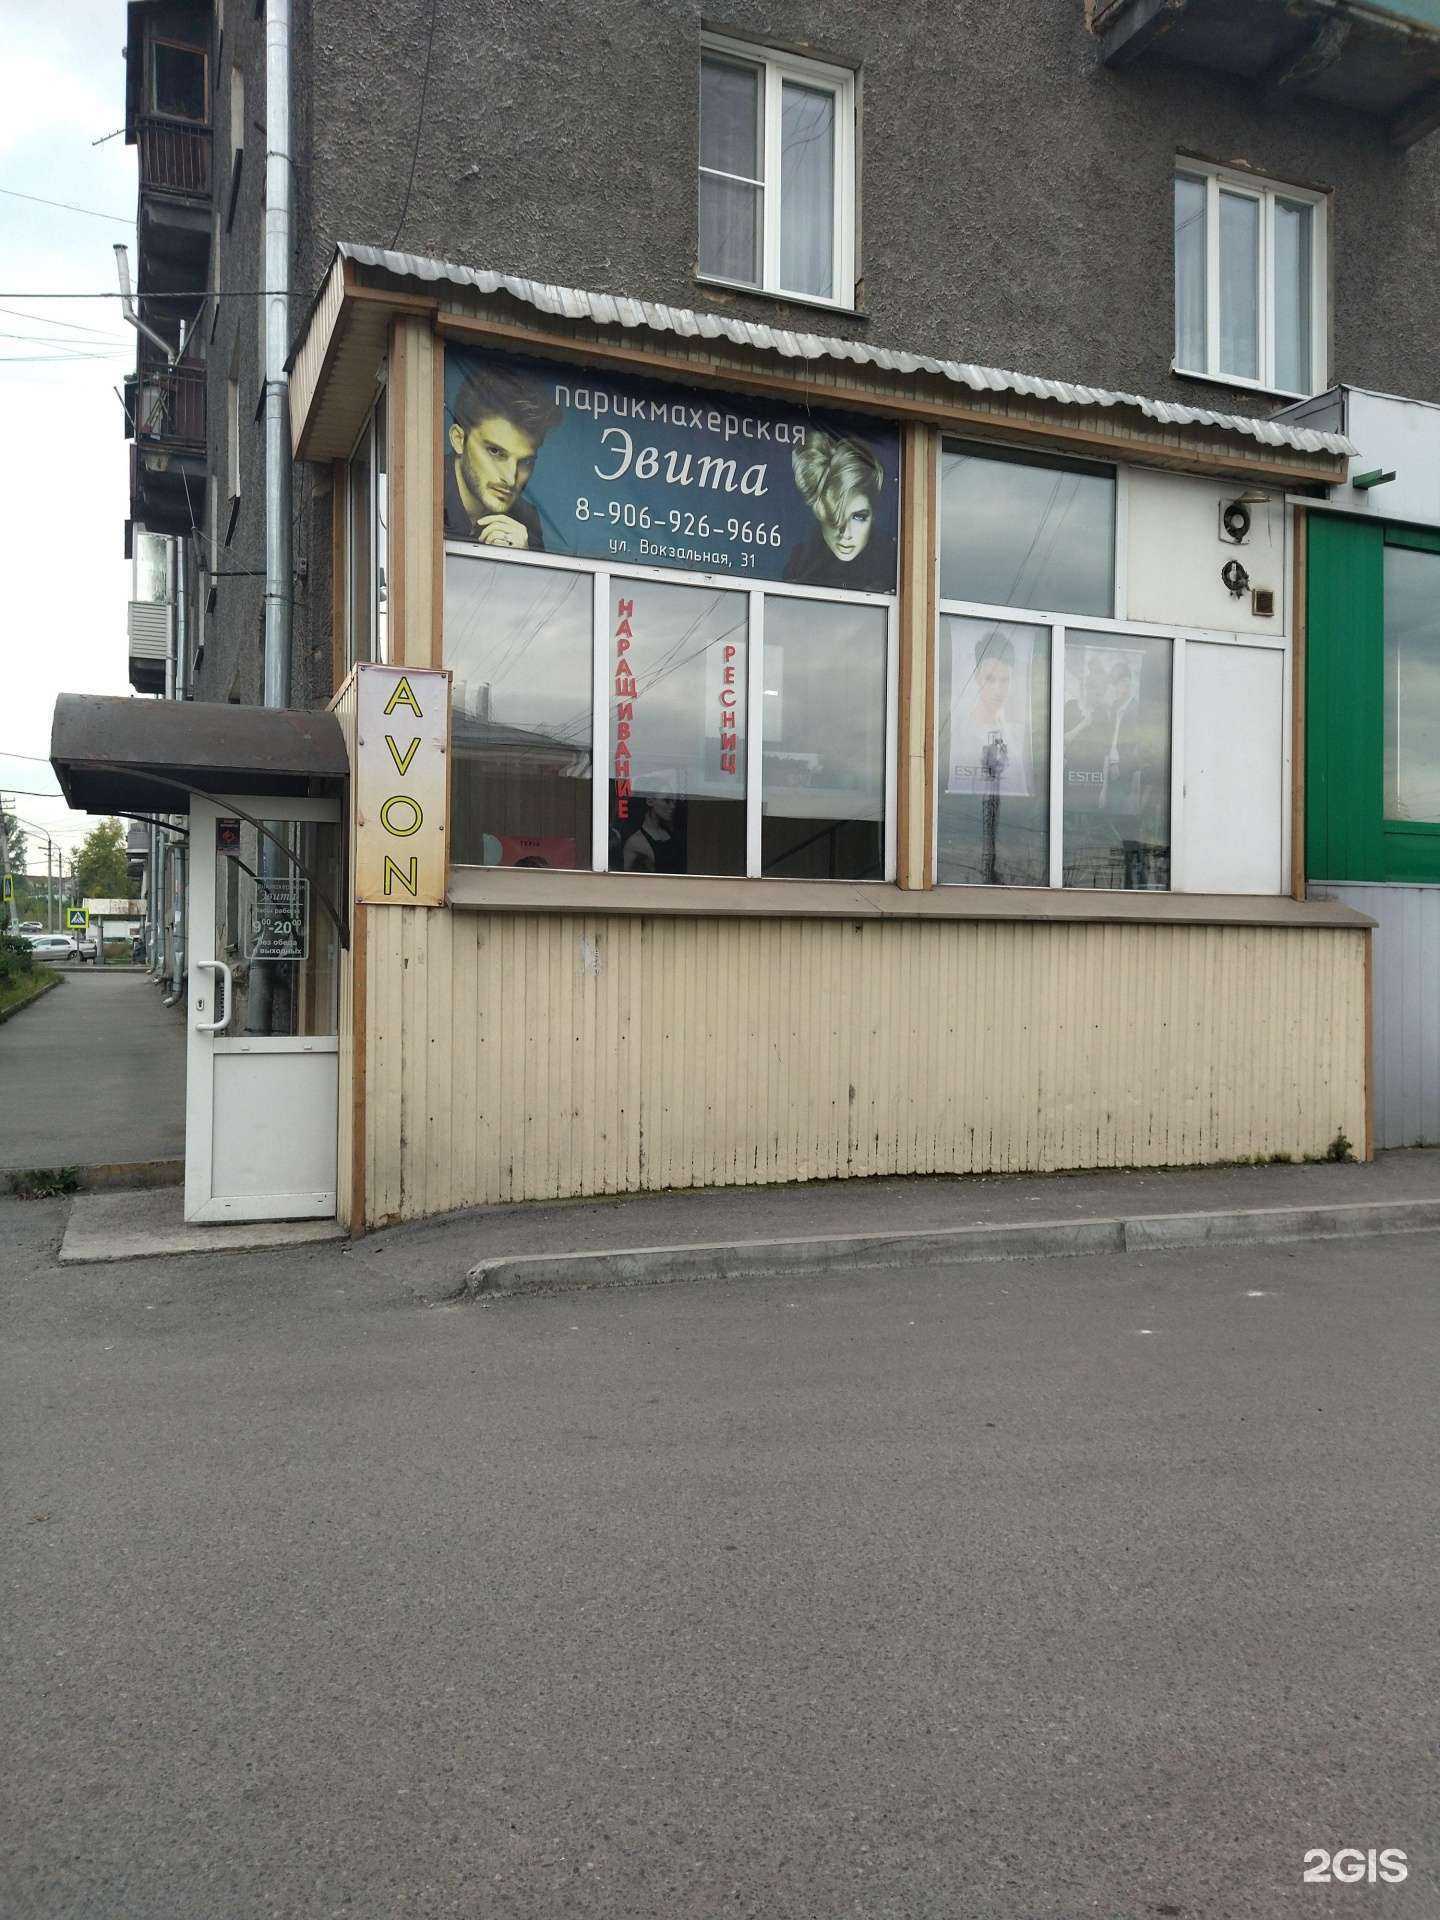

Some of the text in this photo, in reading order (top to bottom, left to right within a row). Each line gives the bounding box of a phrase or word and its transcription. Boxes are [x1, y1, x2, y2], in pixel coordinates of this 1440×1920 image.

[554, 384, 807, 446] парикмахерская
[593, 427, 770, 497] Эвита
[575, 497, 782, 547] 8-906-926-9666
[608, 538, 756, 568] ул. Вокзальная, 31
[615, 598, 638, 821] НАРАЩИВАНИЕ
[719, 645, 737, 776] РЕСНИЦ
[379, 676, 423, 896] AVON
[1067, 770, 1104, 785] ESTEL
